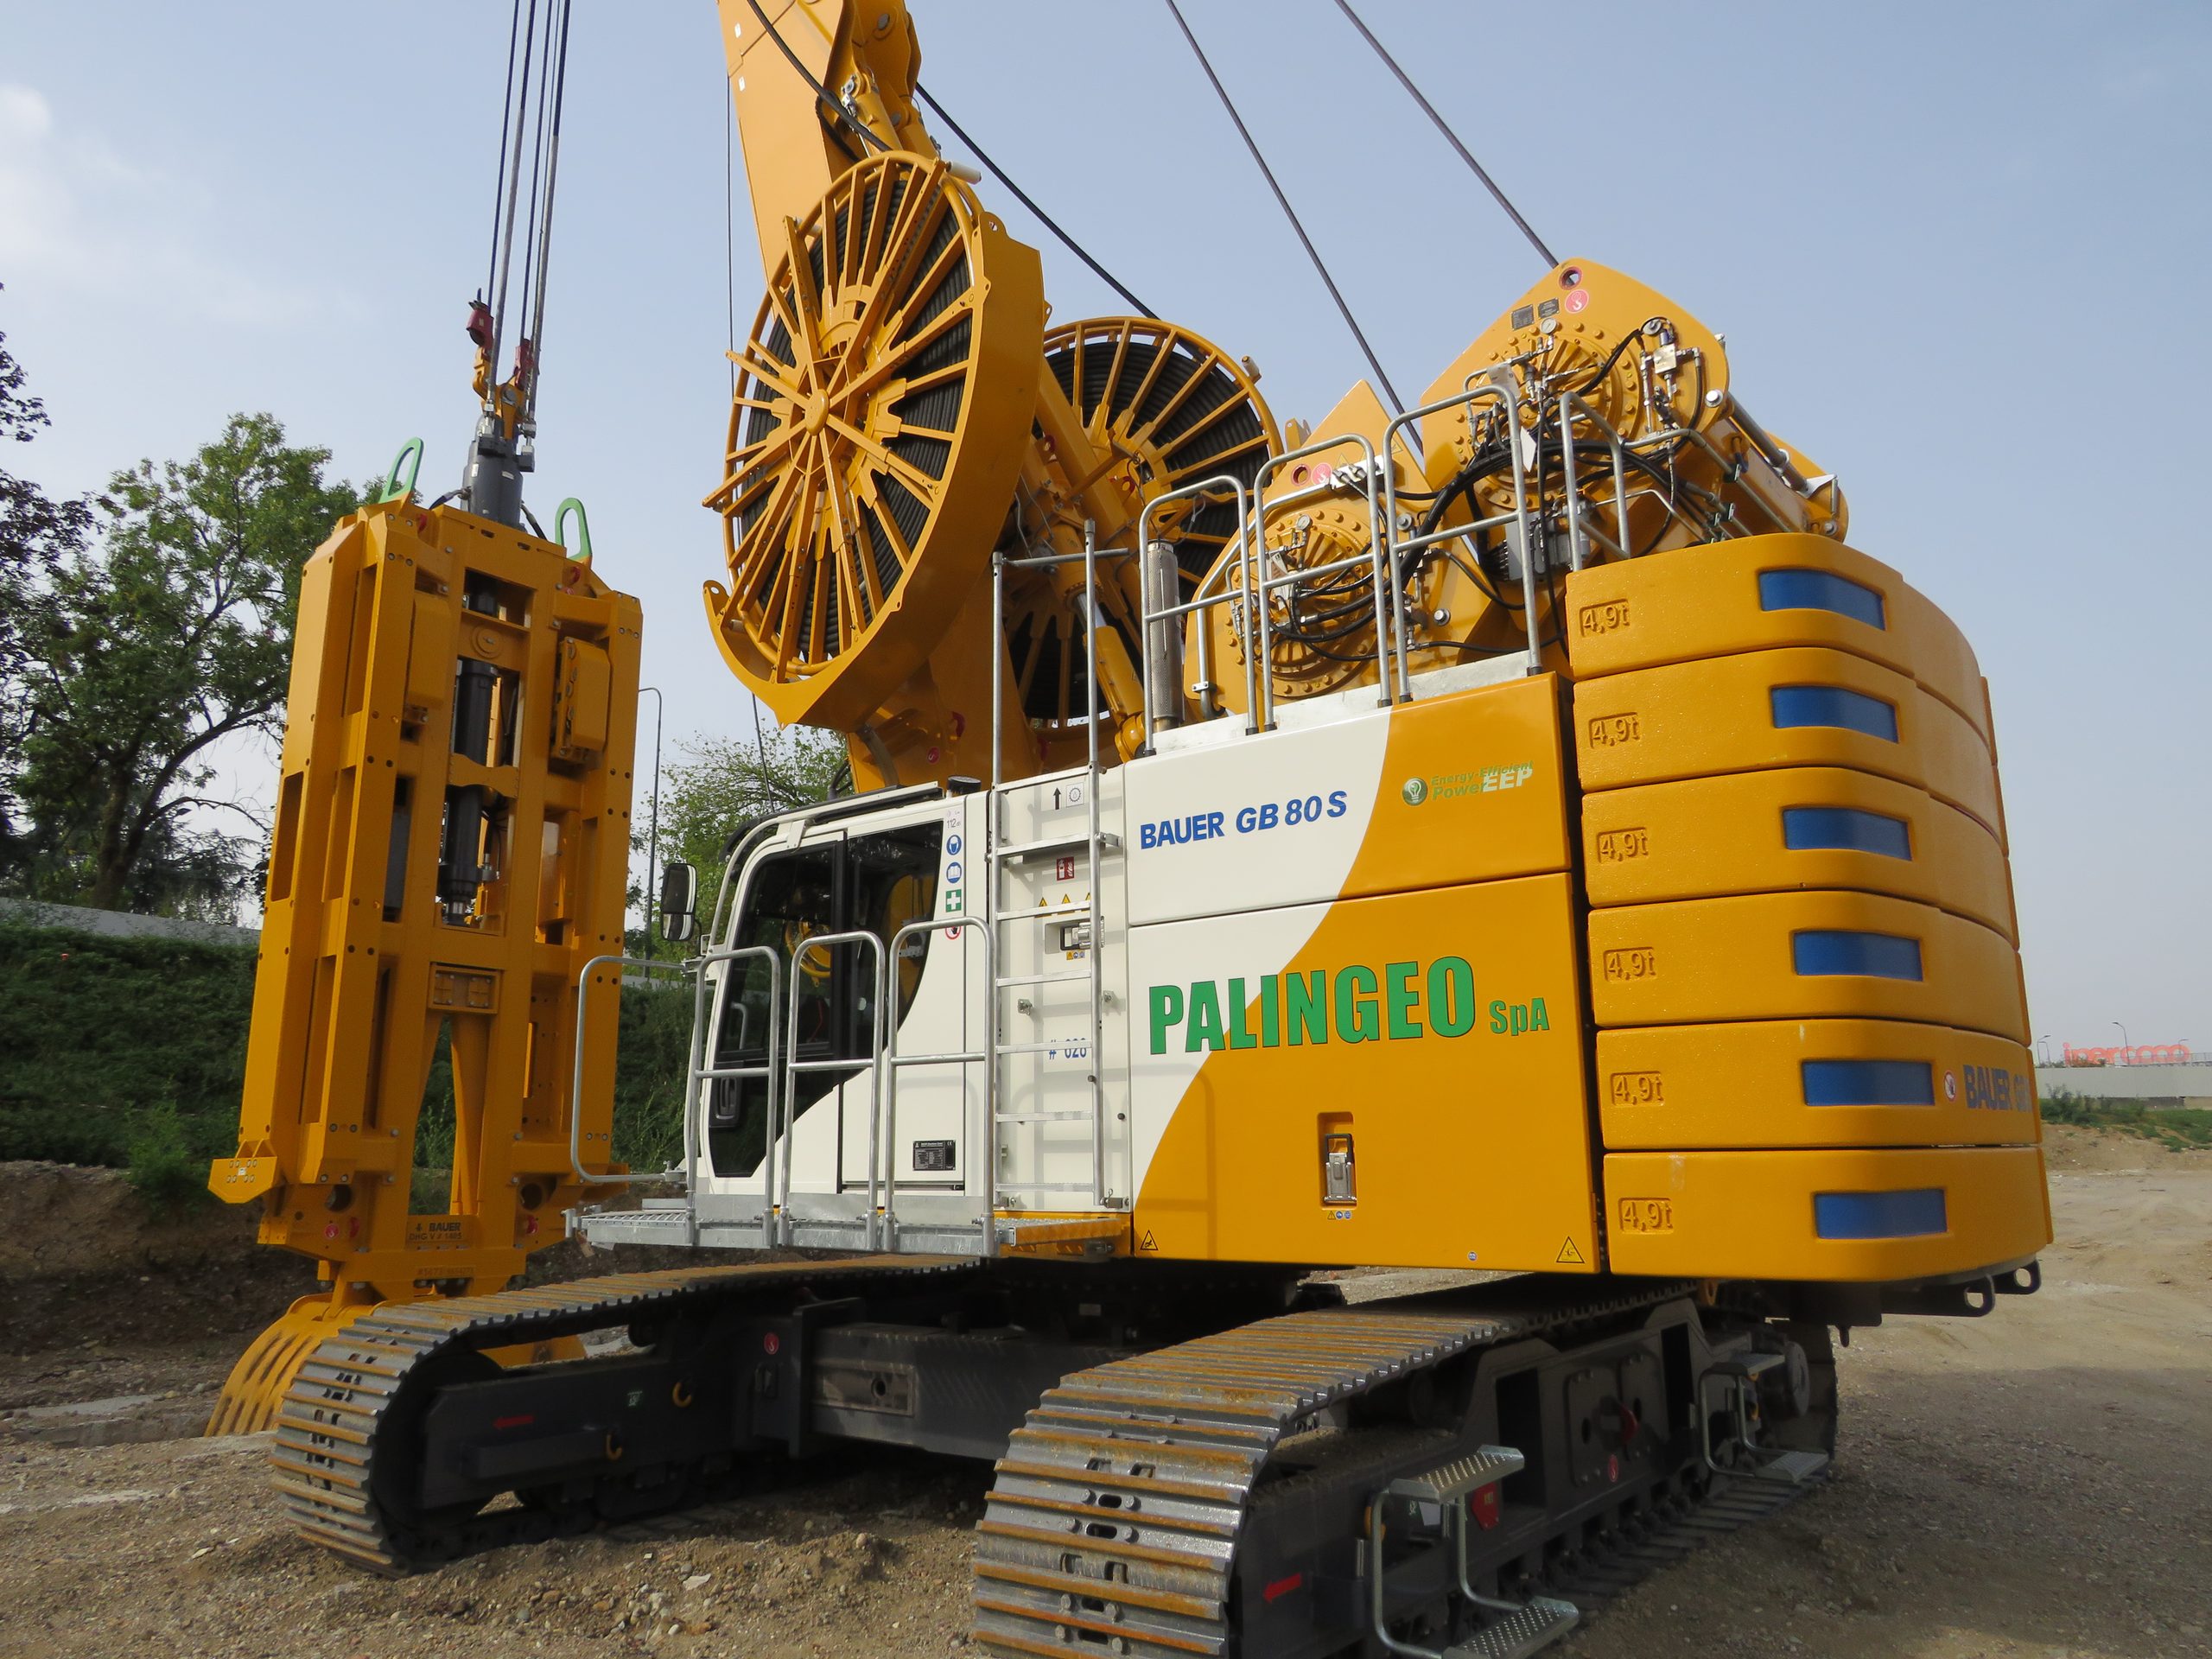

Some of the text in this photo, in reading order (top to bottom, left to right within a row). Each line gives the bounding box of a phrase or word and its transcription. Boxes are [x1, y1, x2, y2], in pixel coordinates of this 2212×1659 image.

[1582, 604, 1630, 636] 4,9t
[1592, 715, 1640, 747] 4,9t
[1140, 811, 1225, 849] BAUER
[1599, 830, 1648, 862] 4,9t
[1606, 950, 1656, 982] 4,9t
[1148, 956, 1550, 1055] PALINGEO SpA
[1613, 1075, 1665, 1105] 4,9t
[1962, 1065, 2012, 1111] BAUER
[429, 1223, 461, 1232] BAUER
[1621, 1200, 1673, 1233] 4,9t
